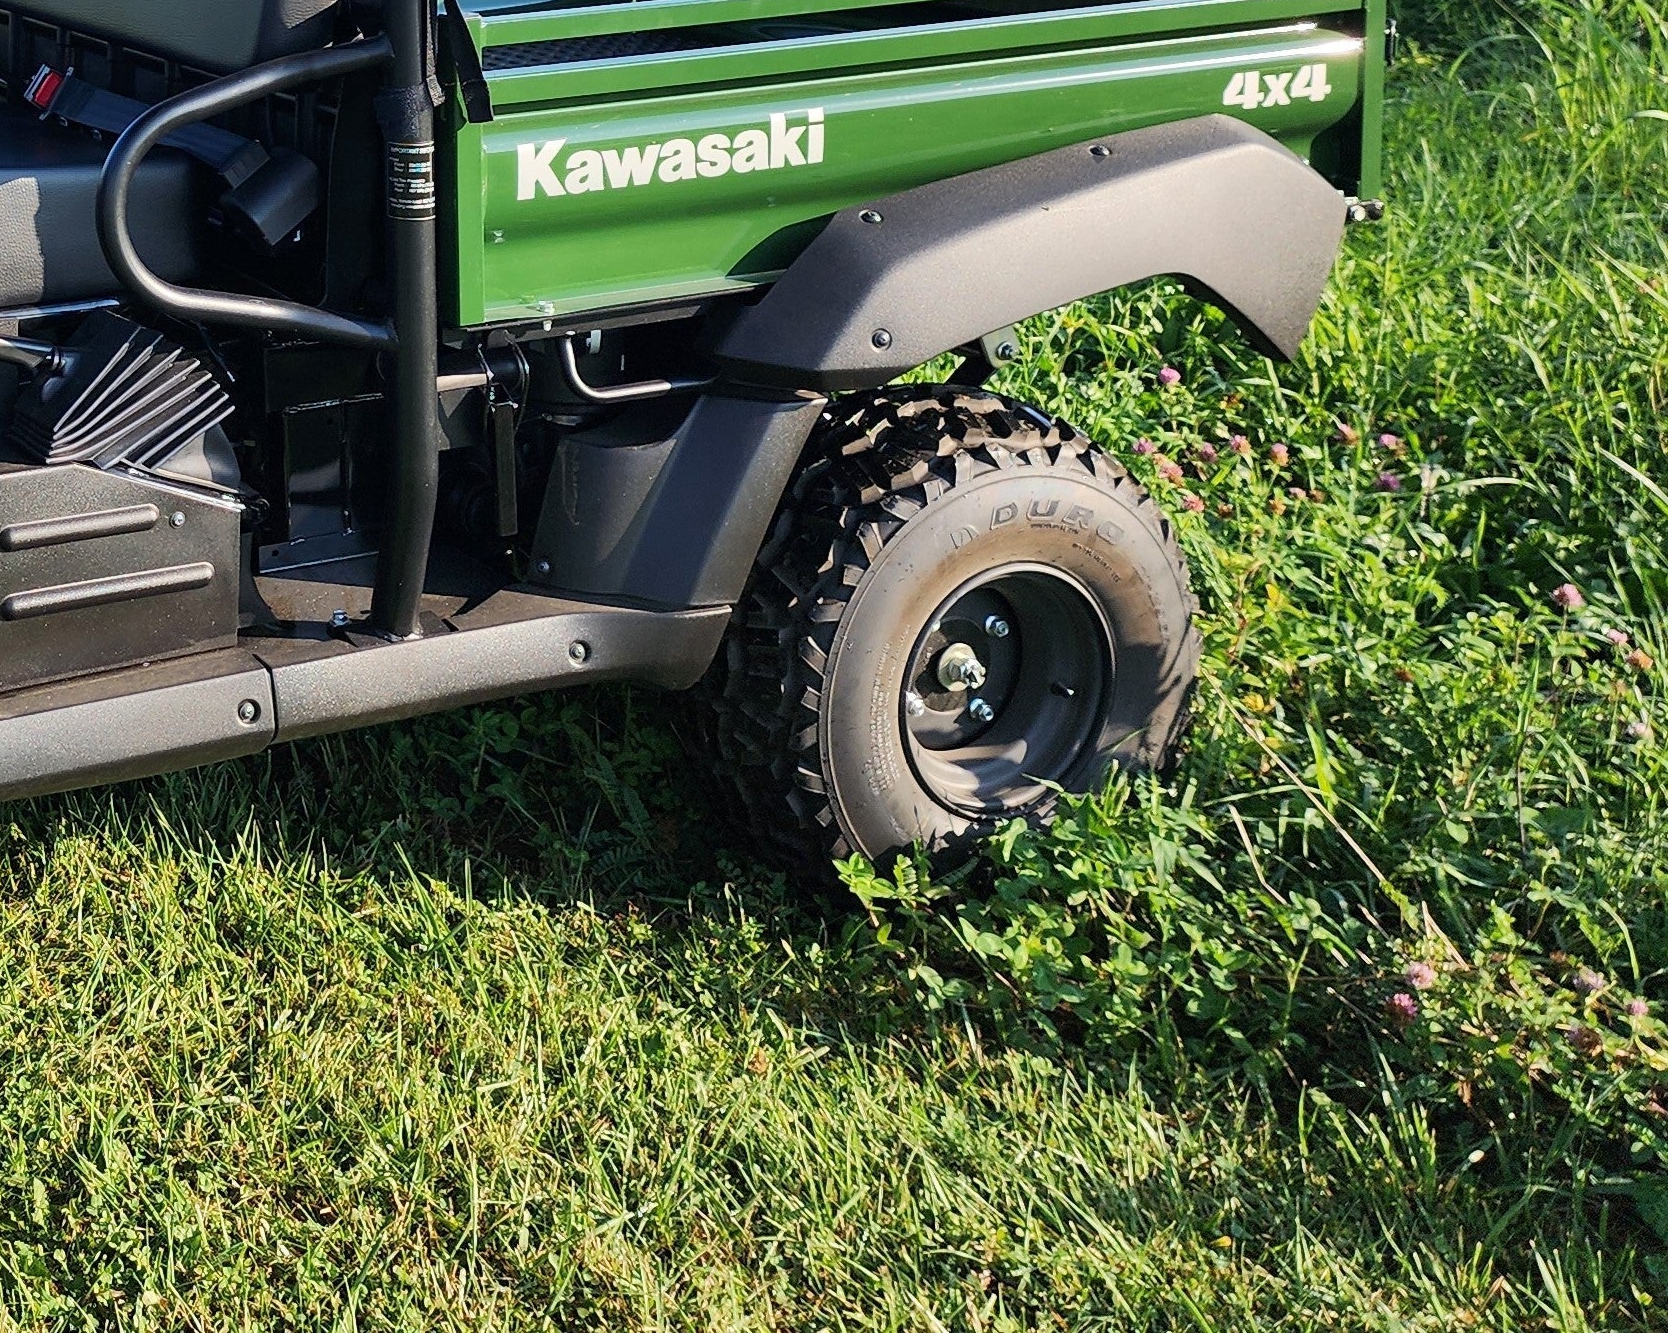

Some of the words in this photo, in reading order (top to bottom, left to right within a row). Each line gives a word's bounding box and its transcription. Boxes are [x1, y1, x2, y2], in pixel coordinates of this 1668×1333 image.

[1223, 63, 1331, 109] 4x4
[517, 107, 825, 201] Kawasaki
[989, 499, 1125, 546] DURO
